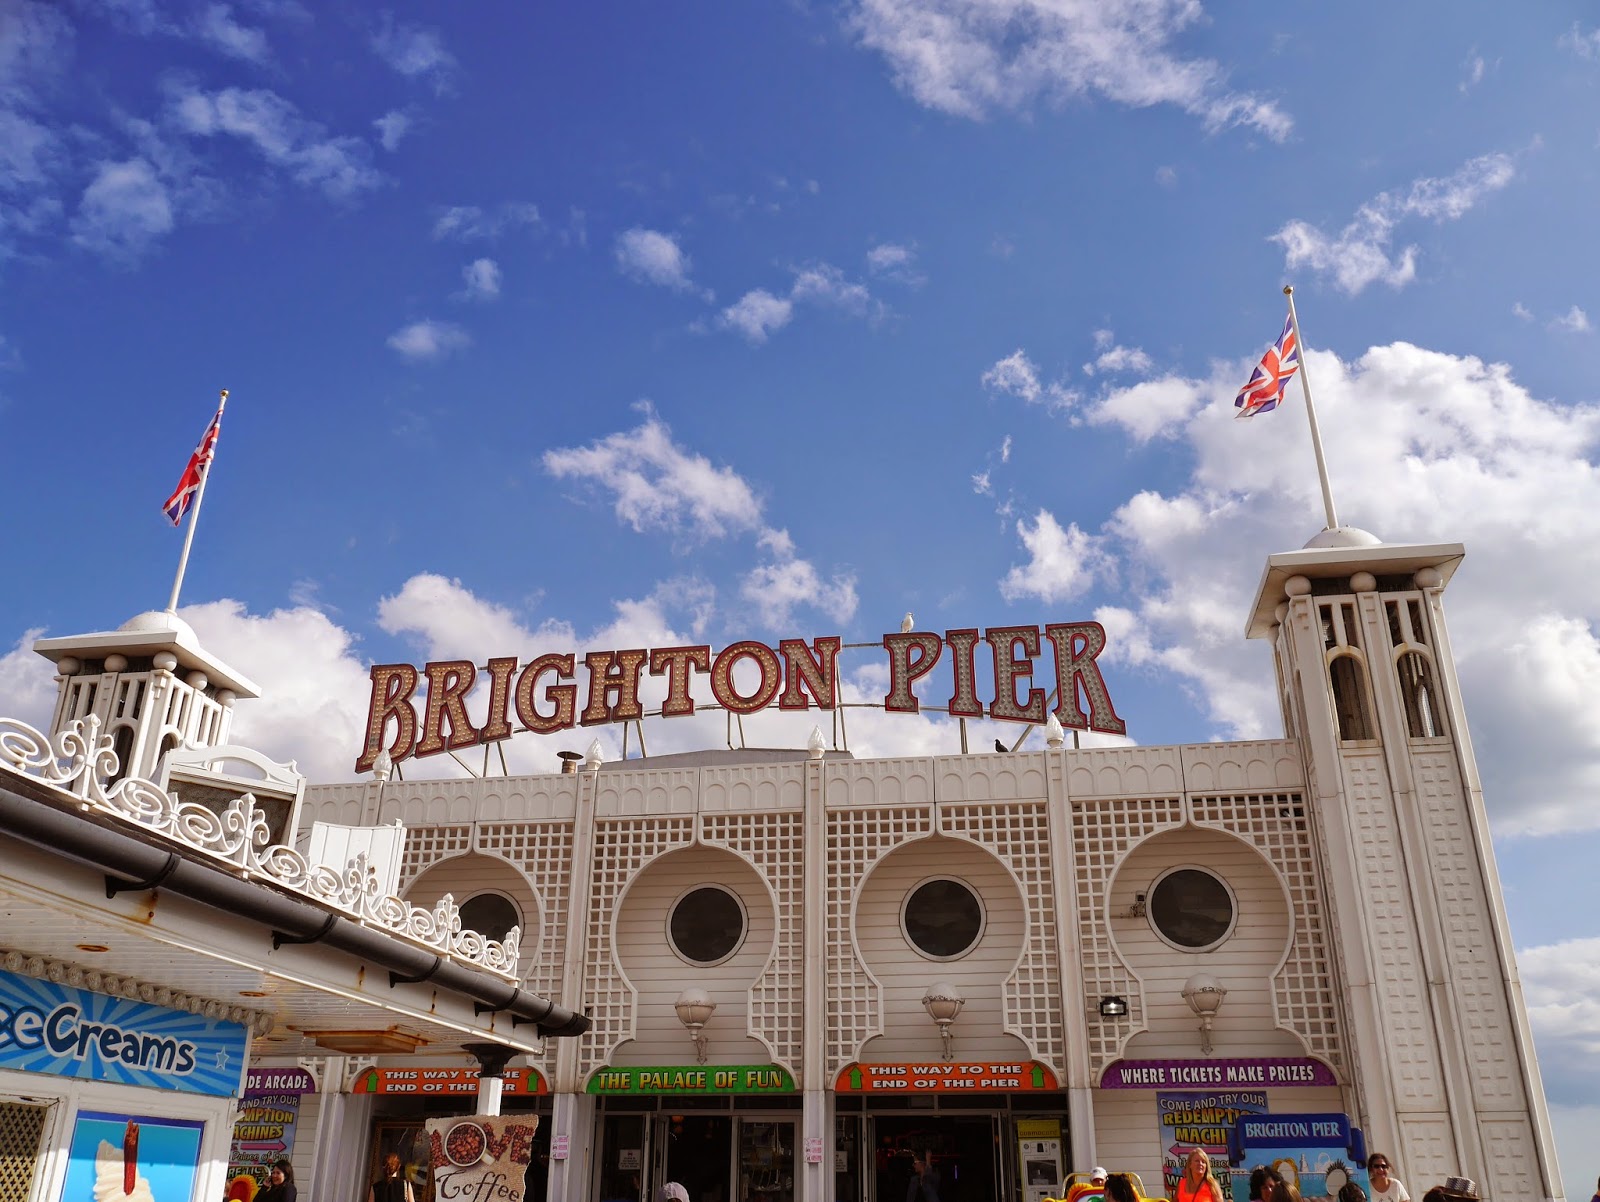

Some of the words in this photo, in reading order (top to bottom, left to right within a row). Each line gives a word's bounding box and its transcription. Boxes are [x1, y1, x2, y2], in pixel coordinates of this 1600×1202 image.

[355, 635, 842, 774] BRIGHTON
[883, 621, 1126, 737] PIER
[44, 1002, 198, 1076] Creams
[385, 1071, 418, 1079] THIS
[423, 1071, 460, 1079] WAY
[502, 1070, 520, 1079] HE
[869, 1066, 907, 1075] THIS
[912, 1066, 953, 1075] WAY
[959, 1066, 984, 1074] TO
[990, 1065, 1022, 1074] THE
[1120, 1068, 1166, 1084] WHERE
[1170, 1067, 1222, 1083] TICKETS
[1226, 1066, 1265, 1083] MAKE
[1269, 1065, 1315, 1082] PRIZES
[246, 1075, 262, 1089] DE
[264, 1075, 309, 1089] ARCADE
[448, 1083, 477, 1091] THE
[597, 1072, 631, 1090] THE
[639, 1071, 706, 1089] PALACE
[715, 1071, 738, 1088] OF
[746, 1070, 783, 1088] FUN
[872, 1080, 908, 1088] END
[914, 1080, 937, 1088] OF
[943, 1079, 975, 1088] THE
[981, 1079, 1020, 1087] PIER
[241, 1098, 260, 1109] AND
[262, 1095, 279, 1106] TRY
[280, 1094, 298, 1107] OUR
[1160, 1098, 1192, 1111] COME
[1194, 1097, 1217, 1109] AND
[1219, 1093, 1239, 1105] TRY
[1241, 1093, 1266, 1107] OUR
[238, 1107, 294, 1124] MPTION
[1245, 1122, 1309, 1138] BRIGHTON
[1311, 1121, 1342, 1137] PIER
[436, 1170, 520, 1202] Coffee
